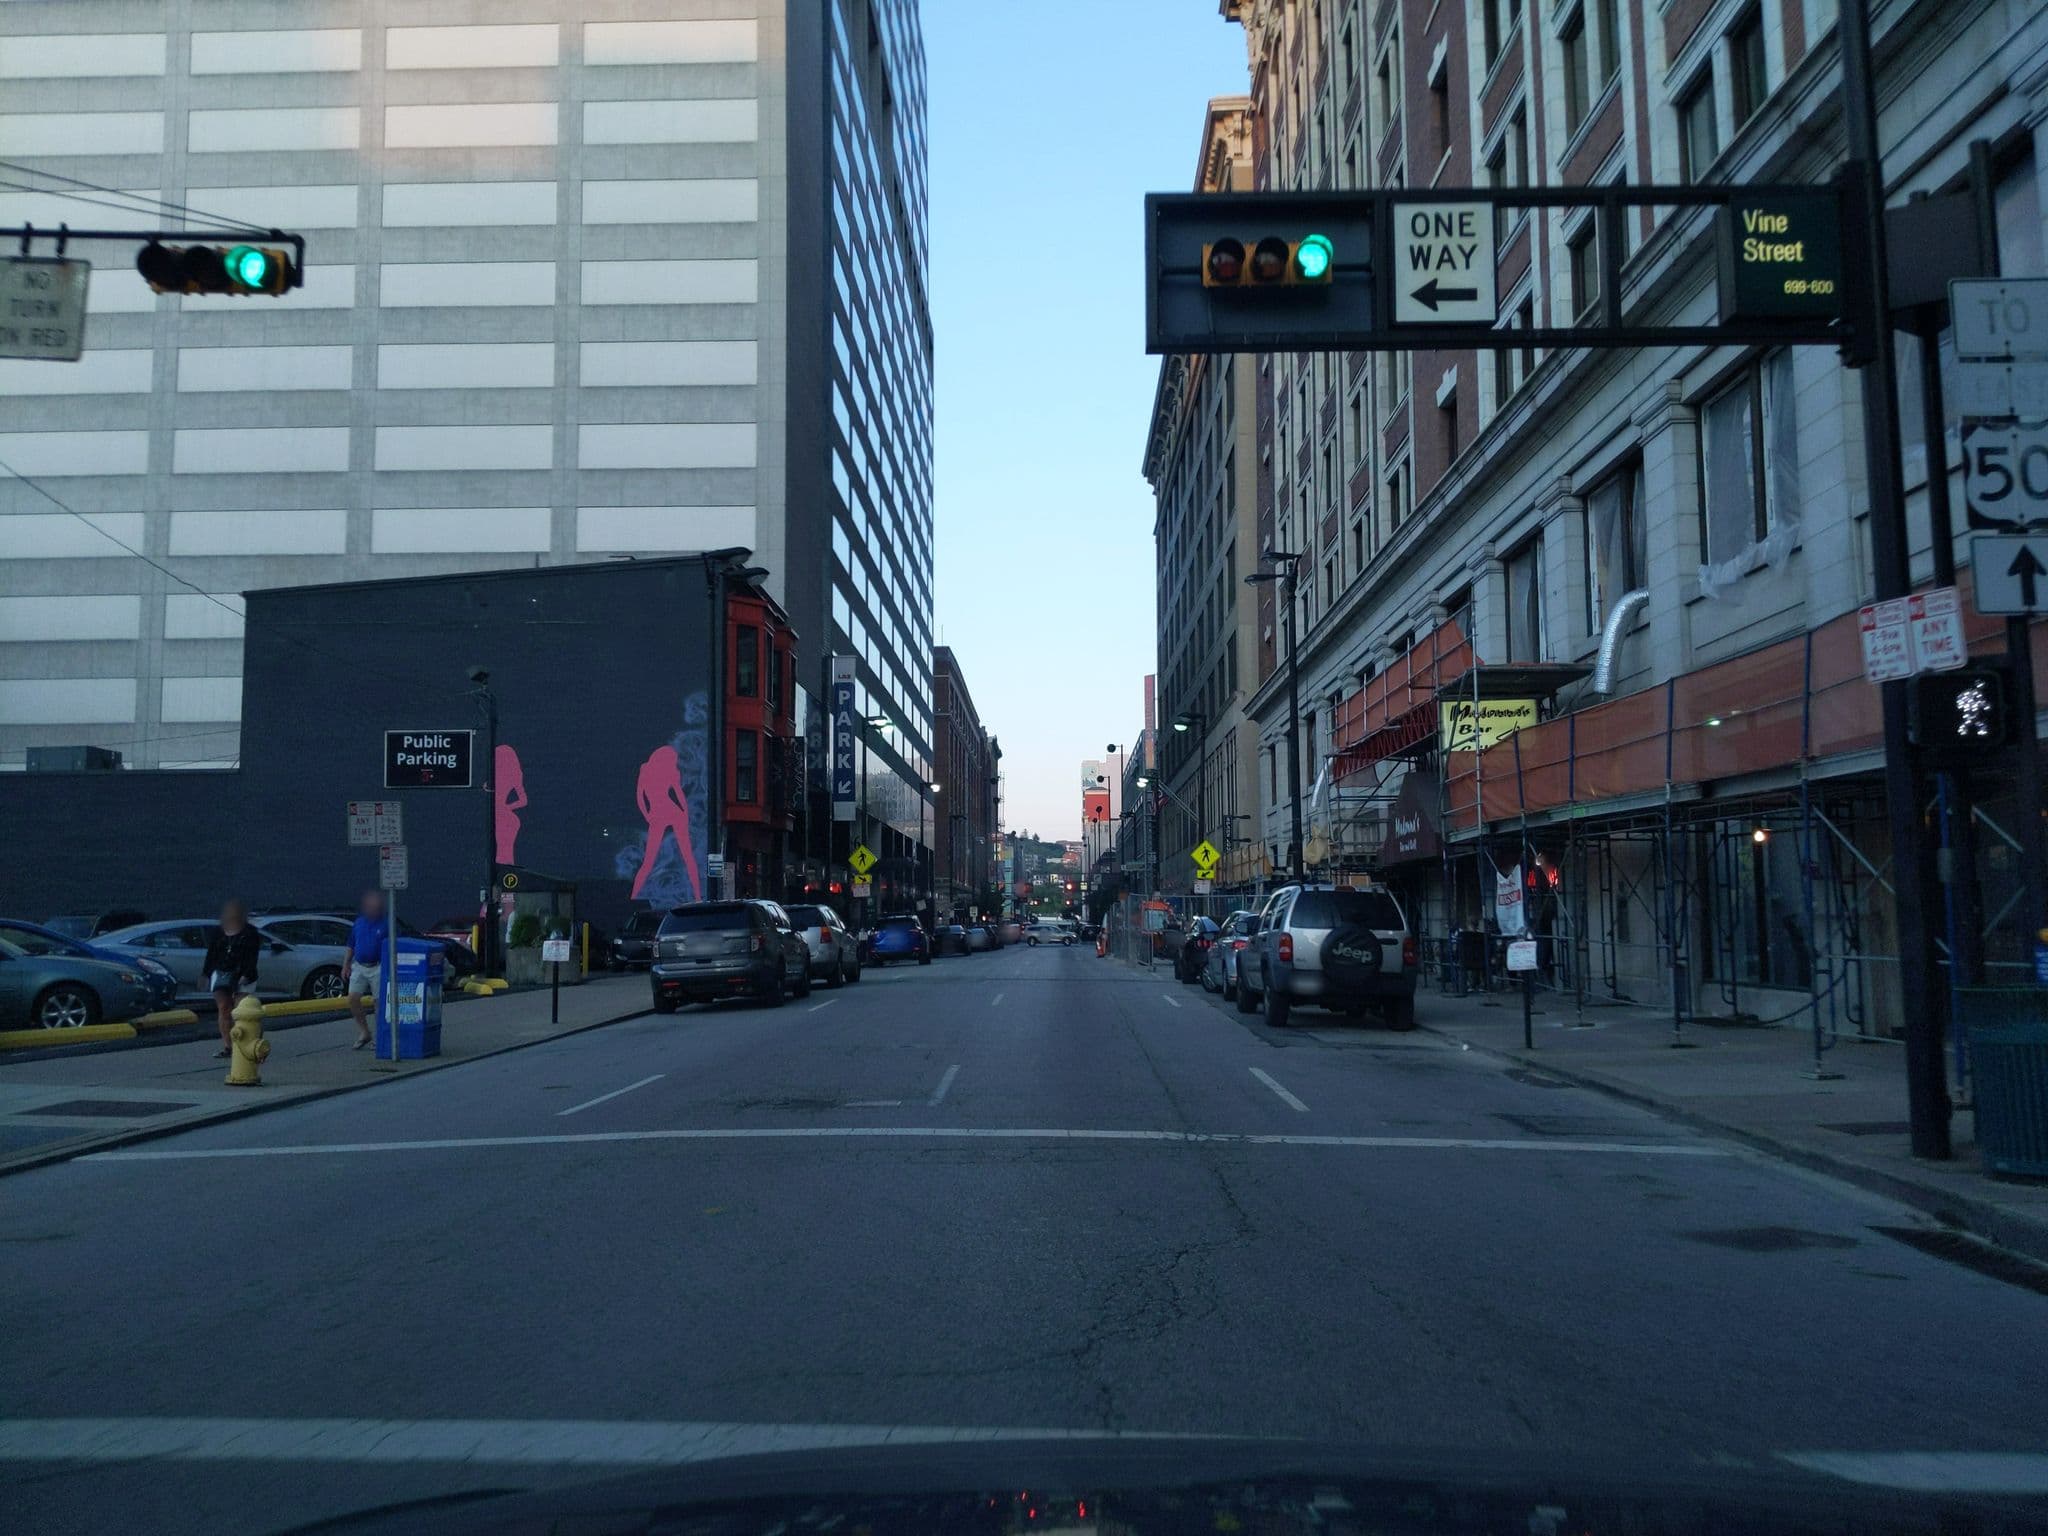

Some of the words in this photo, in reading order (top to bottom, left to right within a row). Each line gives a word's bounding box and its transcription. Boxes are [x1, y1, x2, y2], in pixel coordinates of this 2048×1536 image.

[1411, 211, 1477, 238] ONE
[1743, 208, 1788, 234] Vine
[1409, 244, 1479, 271] WAY
[1743, 238, 1804, 263] Street
[24, 272, 50, 289] NO
[9, 298, 61, 318] TURN
[1979, 298, 2030, 334] TO
[30, 328, 67, 347] RED
[1976, 445, 2048, 503] 50
[1922, 619, 1949, 637] ANY
[1921, 636, 1954, 655] TIME
[836, 689, 852, 769] PARK
[403, 734, 451, 748] Public
[396, 751, 458, 769] Parking
[355, 816, 370, 825] ANY
[353, 827, 373, 837] TIME
[1332, 943, 1373, 964] Jeep
